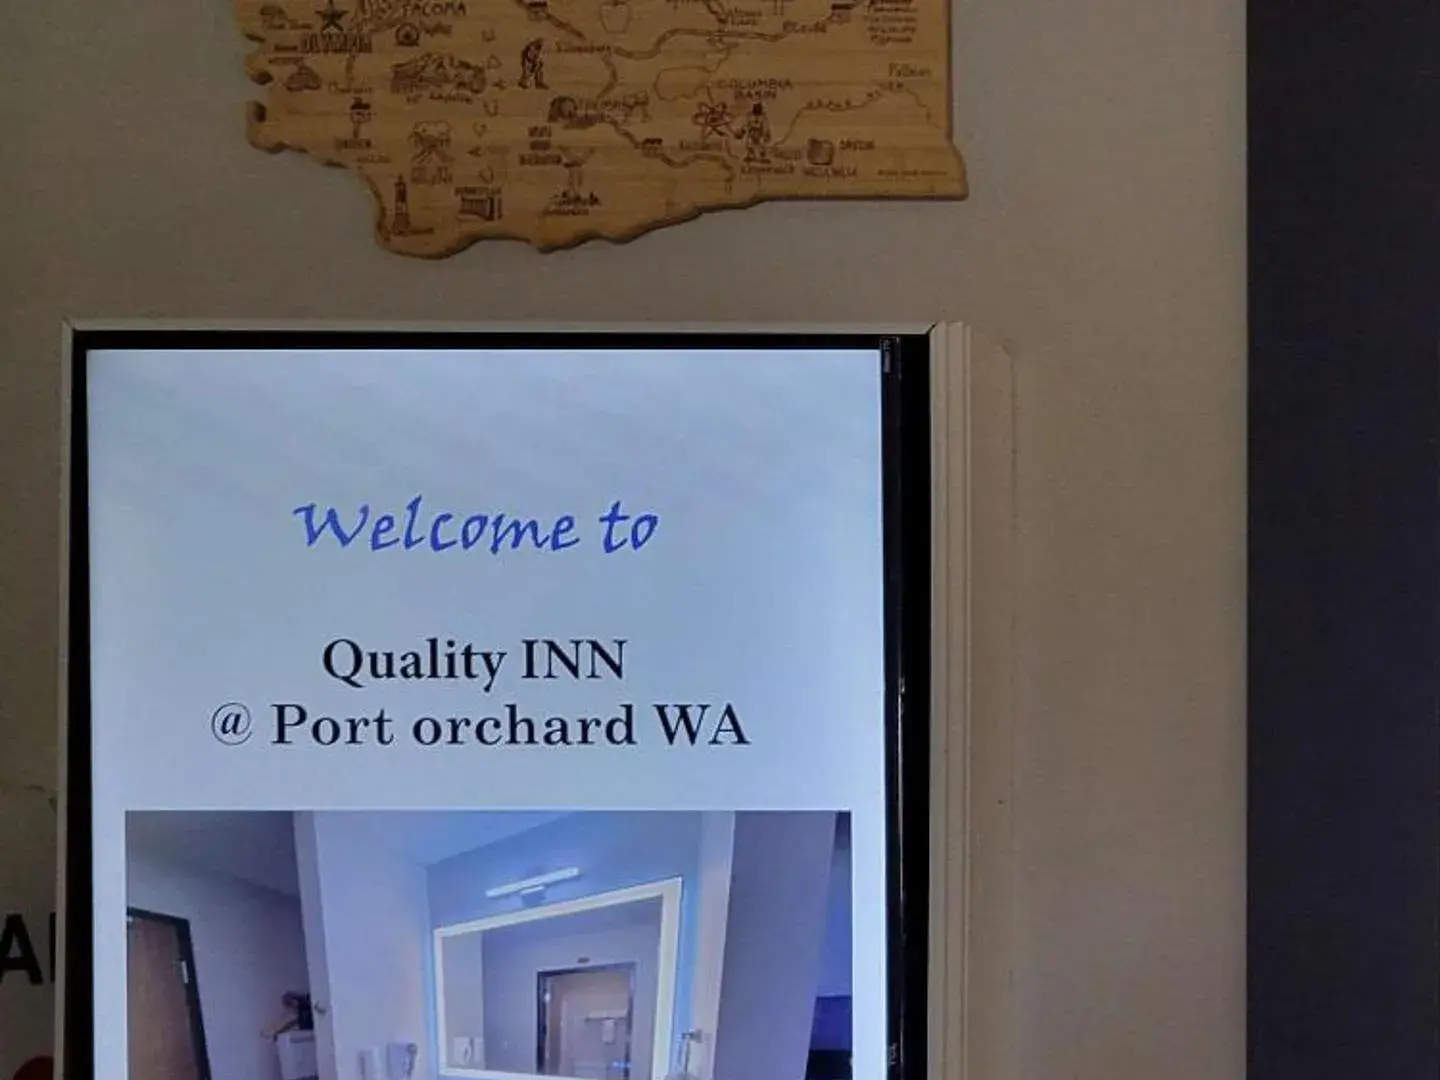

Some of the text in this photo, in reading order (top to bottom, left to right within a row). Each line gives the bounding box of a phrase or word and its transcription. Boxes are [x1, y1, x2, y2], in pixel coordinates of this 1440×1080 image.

[293, 495, 658, 555] Welcome to
[322, 637, 628, 693] Quality INN
[211, 702, 750, 746] @ Port orchard WA
